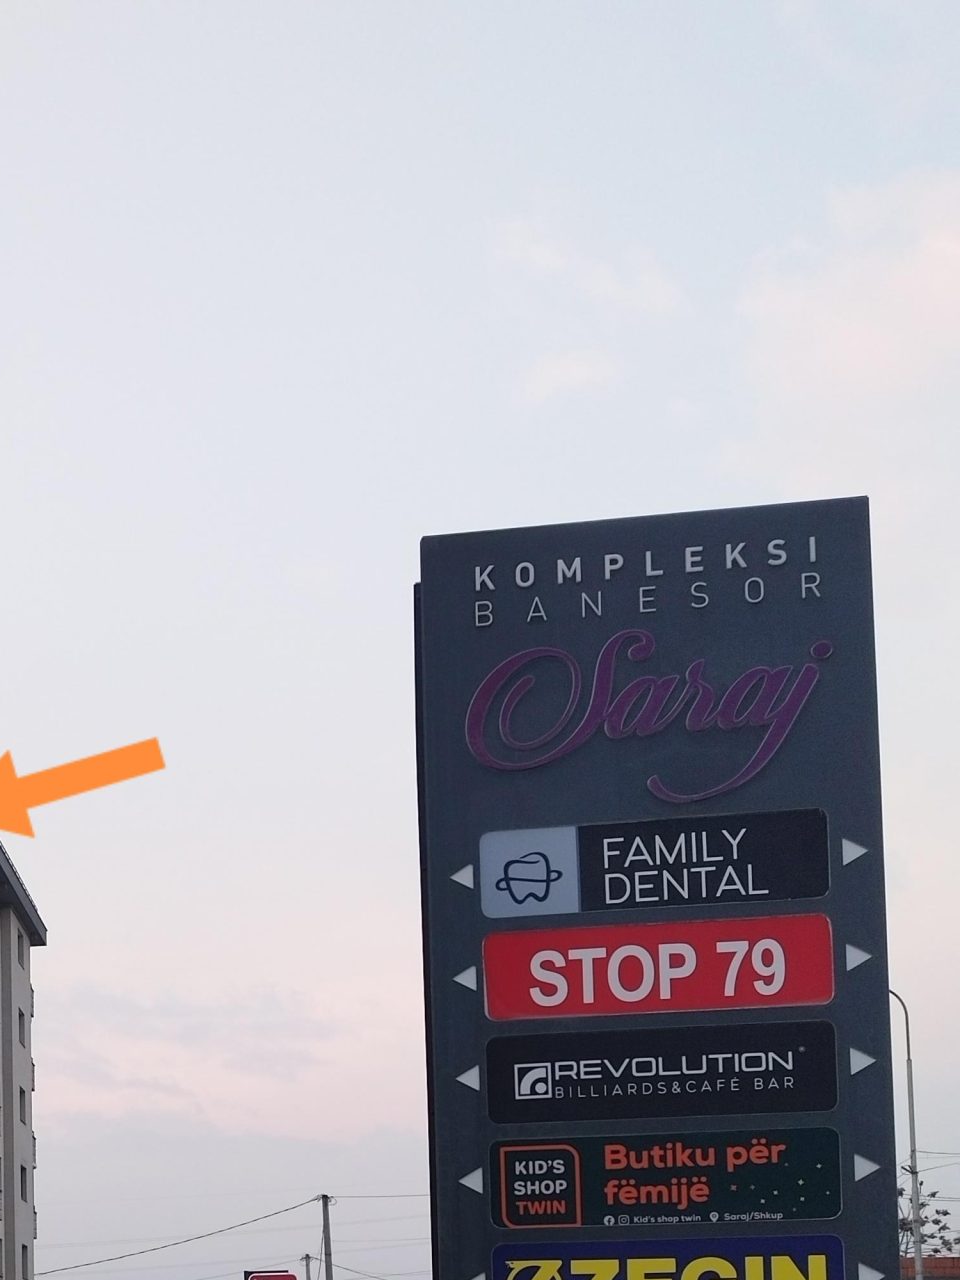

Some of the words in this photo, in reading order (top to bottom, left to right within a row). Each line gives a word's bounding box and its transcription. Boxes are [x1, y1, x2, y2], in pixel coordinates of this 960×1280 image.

[474, 536, 817, 592] KOMPLEKSI
[474, 572, 822, 628] BANESOR
[465, 628, 834, 804] Saraj
[603, 828, 747, 869] FAMILY
[605, 863, 769, 905] DENTAL
[529, 942, 698, 1007] STOP
[716, 938, 786, 997] 79
[554, 1051, 794, 1081] REVOLUTION
[554, 1076, 741, 1100] BILLIARDS&CAFÉ
[753, 1076, 794, 1090] BAR
[603, 1142, 716, 1170] Butiku
[726, 1137, 787, 1173] për
[513, 1180, 568, 1196] SHOP
[603, 1176, 711, 1210] fëmijë
[515, 1200, 567, 1216] TWIN
[657, 1215, 679, 1225] shop
[681, 1214, 702, 1222] twin
[723, 1211, 784, 1222] Saraj/Shkup
